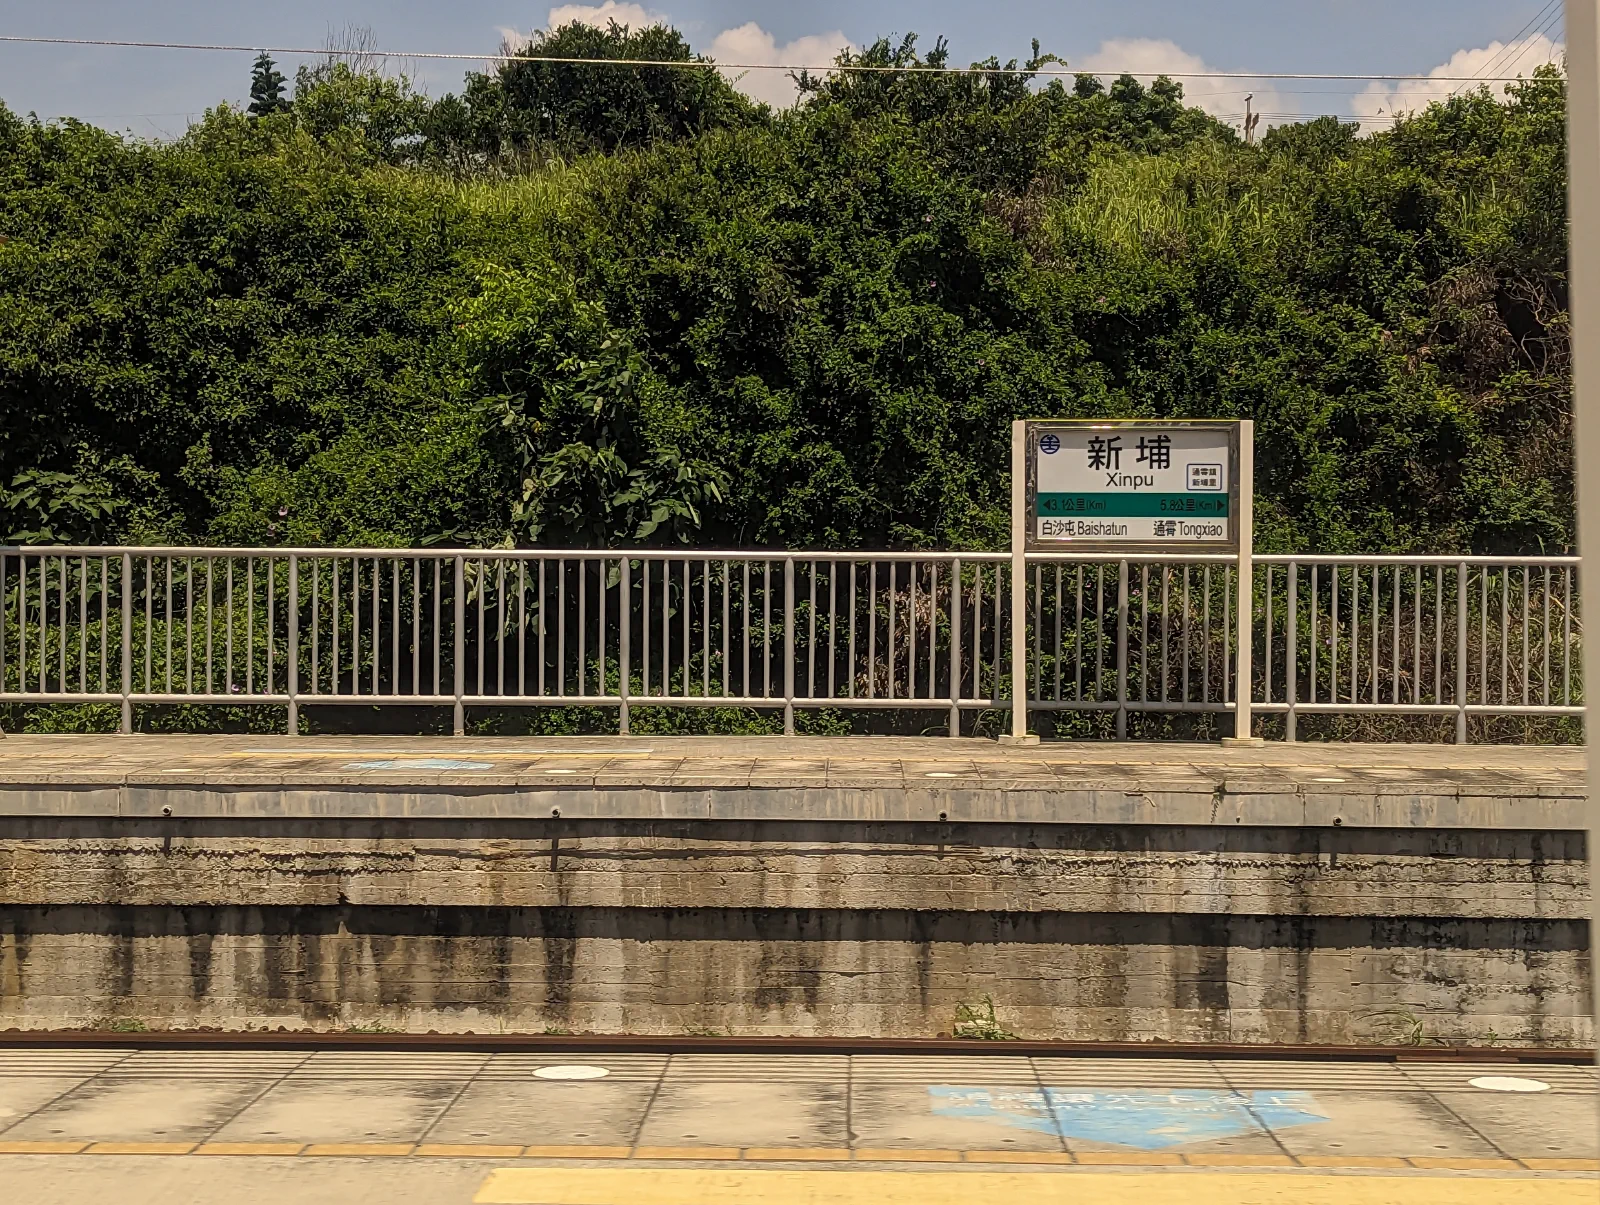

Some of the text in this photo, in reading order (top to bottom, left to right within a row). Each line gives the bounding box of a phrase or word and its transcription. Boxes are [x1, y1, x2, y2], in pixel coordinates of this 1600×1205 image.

[1087, 434, 1172, 471] 新埔
[1105, 472, 1154, 490] Xinpu
[1042, 520, 1128, 536] 白沙屯 Baishatun
[1153, 520, 1223, 539] 通霄 Tongxiao
